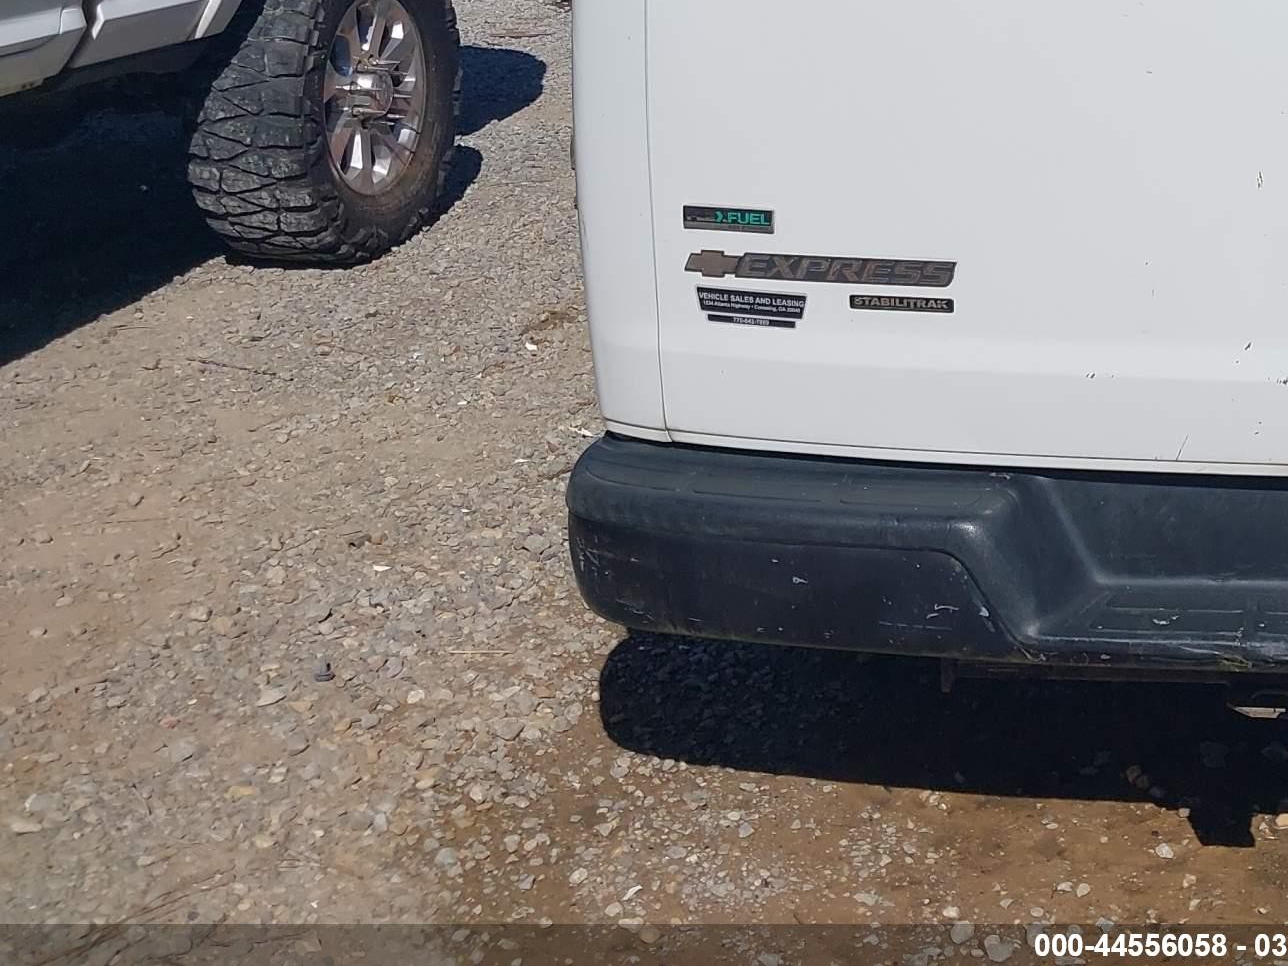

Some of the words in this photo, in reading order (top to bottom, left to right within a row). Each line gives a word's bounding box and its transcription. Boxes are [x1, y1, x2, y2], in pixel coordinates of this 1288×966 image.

[741, 255, 951, 284] EXPRESS
[699, 292, 729, 301] VEHICLE
[730, 295, 754, 304] SALES
[755, 297, 771, 305] AND
[772, 298, 805, 308] LEASING
[854, 297, 949, 309] STABILITRAK
